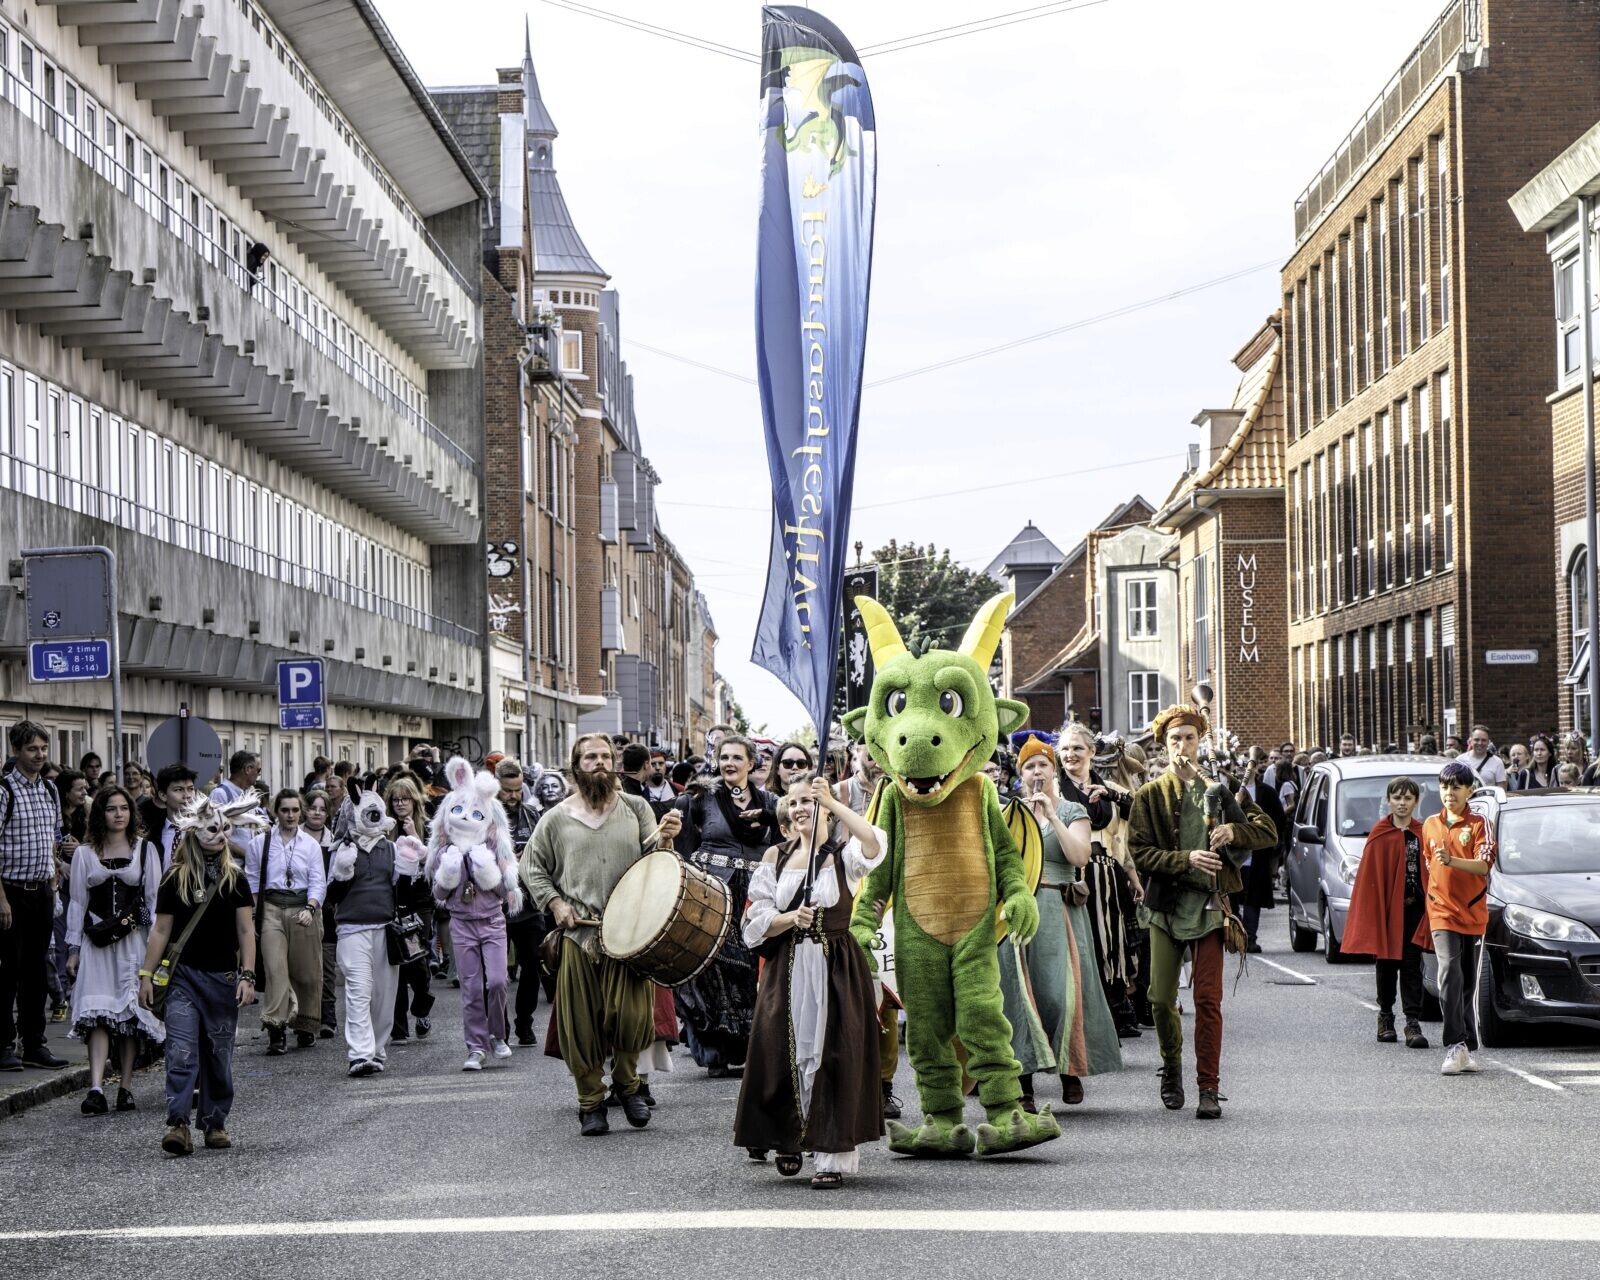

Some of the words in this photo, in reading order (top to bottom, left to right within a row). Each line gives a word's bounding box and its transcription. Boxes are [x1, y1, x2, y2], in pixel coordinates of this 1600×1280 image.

[1237, 553, 1260, 663] MUSEUM
[76, 645, 101, 653] timer
[74, 655, 95, 663] 8-18
[1490, 652, 1531, 661] Esehaven
[71, 664, 99, 672] (8-14)
[289, 667, 313, 700] P
